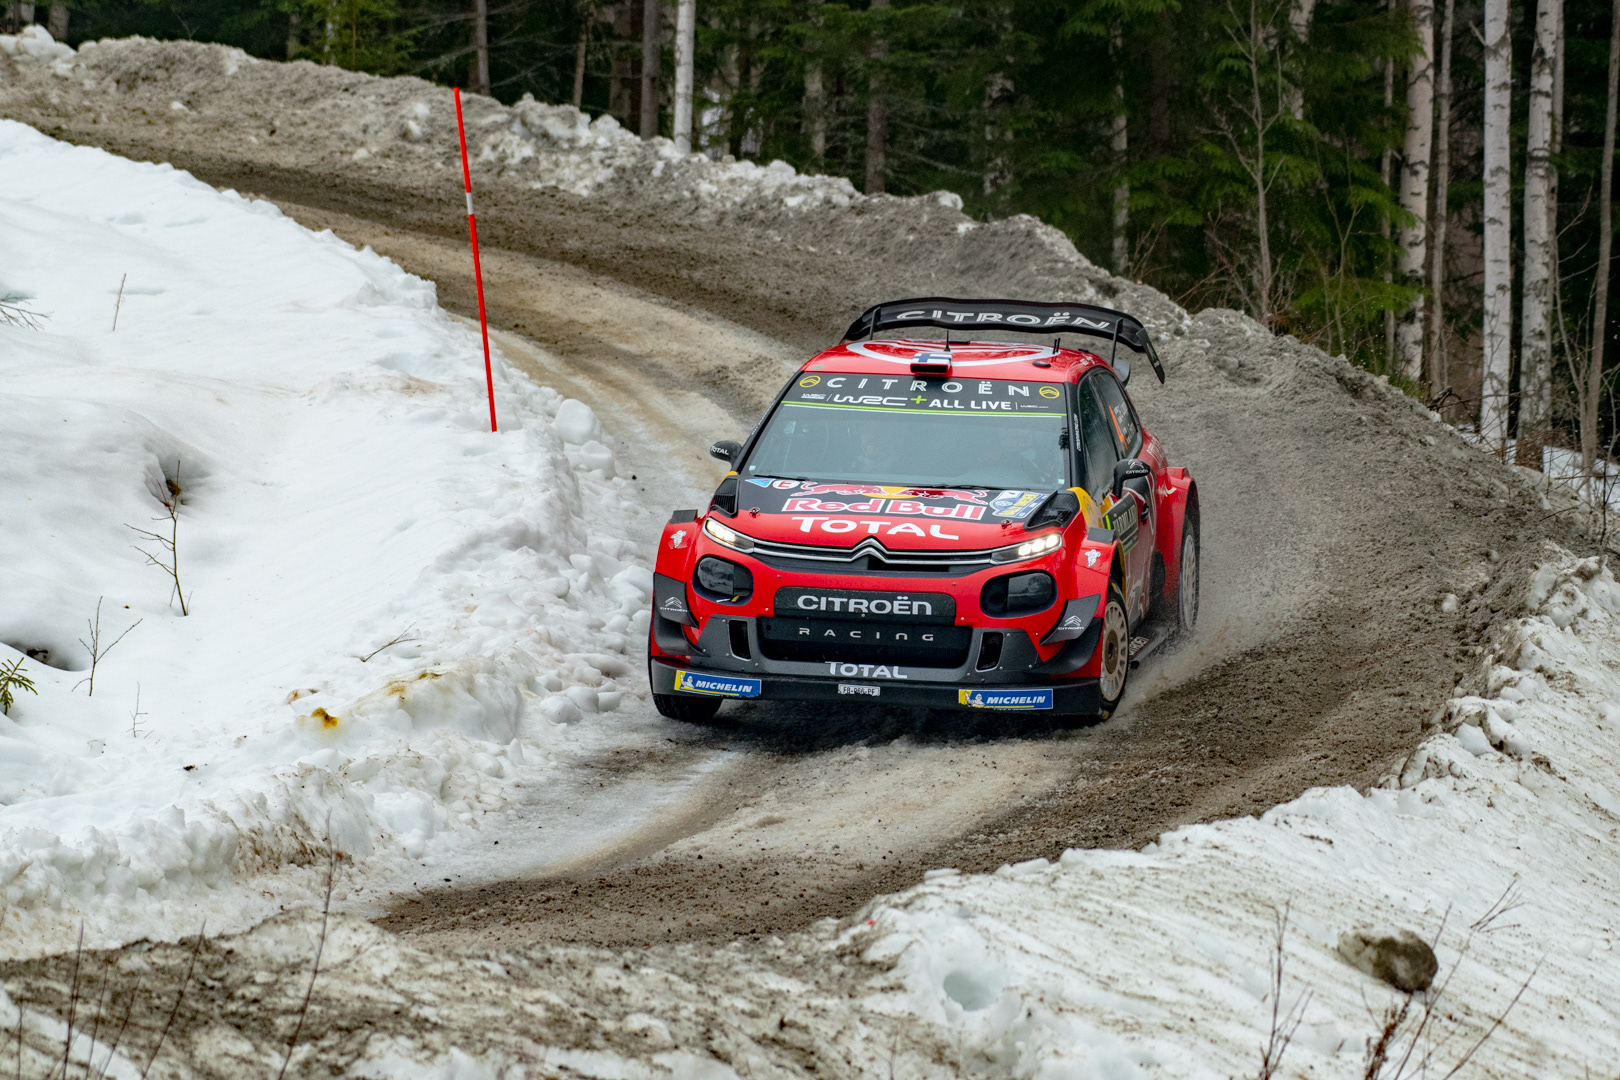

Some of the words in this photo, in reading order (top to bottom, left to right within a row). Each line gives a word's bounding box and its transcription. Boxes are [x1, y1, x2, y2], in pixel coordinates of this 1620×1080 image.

[896, 309, 1110, 330] CITROËN
[826, 376, 1030, 397] CITROËN
[928, 398, 965, 409] ALL
[970, 400, 1012, 410] LIVE
[710, 445, 730, 456] TOTAL
[782, 498, 885, 513] Red
[888, 499, 987, 520] Bull
[792, 517, 960, 540] TOTAL
[797, 595, 933, 616] CITROËN
[798, 627, 935, 642] RACING
[825, 661, 908, 679] TOTAL
[695, 680, 753, 693] MICHELIN
[986, 696, 1046, 705] MICHELIN
